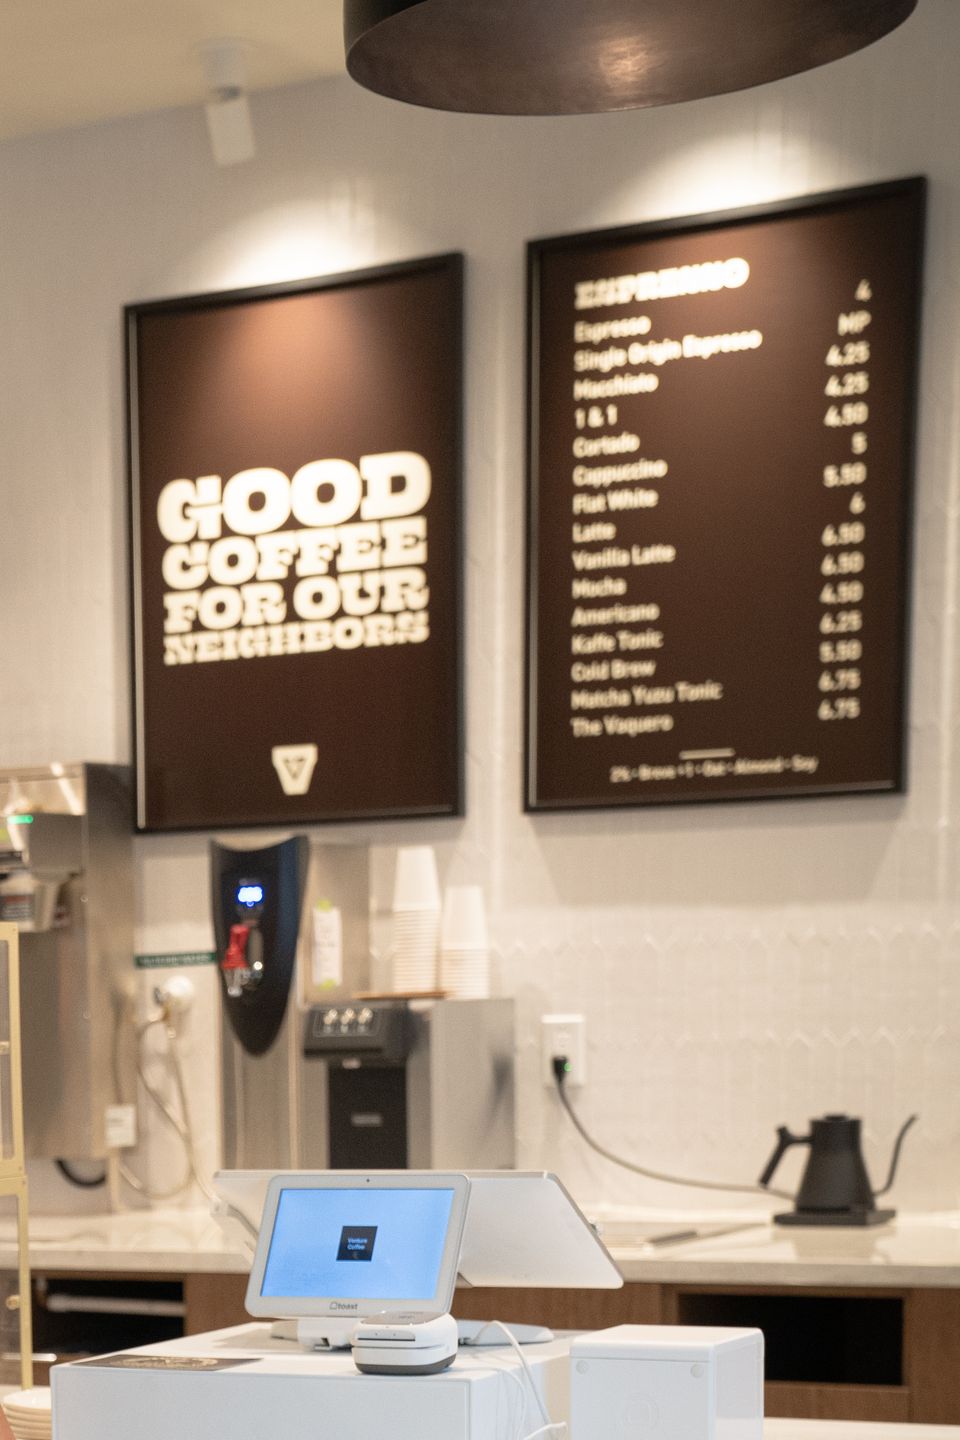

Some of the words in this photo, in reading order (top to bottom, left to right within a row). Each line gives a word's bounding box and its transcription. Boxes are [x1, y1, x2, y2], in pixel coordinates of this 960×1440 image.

[575, 257, 750, 310] ESPRESSO
[574, 316, 651, 344] Espresso
[574, 345, 628, 372] Single
[628, 338, 682, 366] Origin
[682, 329, 763, 359] Espresso
[838, 310, 872, 336] MP
[574, 373, 659, 400] Macchiato
[826, 341, 871, 367] 4.25
[575, 408, 586, 429] 1
[587, 406, 605, 428] &
[606, 404, 618, 426] 1
[825, 372, 870, 397] 4.25
[573, 431, 640, 458] Cortado
[824, 402, 869, 427] 4.50
[572, 458, 668, 488] Cappuccino
[851, 432, 868, 455] 5
[157, 450, 432, 543] GOOD
[573, 493, 606, 515] Flat
[607, 487, 659, 511] White
[824, 461, 867, 487] 5.50
[572, 522, 616, 543] Latte
[849, 491, 866, 515] 6
[161, 515, 428, 590] COFFEE
[572, 547, 631, 571] Vanilla
[631, 544, 677, 566] Latte
[821, 521, 866, 547] 6.50
[163, 581, 287, 634] FOR
[293, 566, 430, 620] OUR
[572, 576, 627, 599] Mocha
[821, 551, 865, 576] 6.50
[571, 603, 660, 627] Americano
[820, 580, 864, 604] 4.50
[163, 610, 430, 667] NEIGHBORS
[571, 632, 616, 655] Kaffe
[617, 628, 664, 650] Tonic
[819, 610, 863, 635] 6.25
[571, 660, 610, 682] Cold
[610, 659, 656, 680] Brew
[819, 639, 863, 663] 5.50
[571, 688, 632, 710] Matcha
[632, 685, 675, 705] Yuzu
[675, 680, 723, 702] Tonic
[570, 717, 603, 738] The
[603, 714, 674, 737] Vaquero
[337, 1302, 358, 1310] toast
